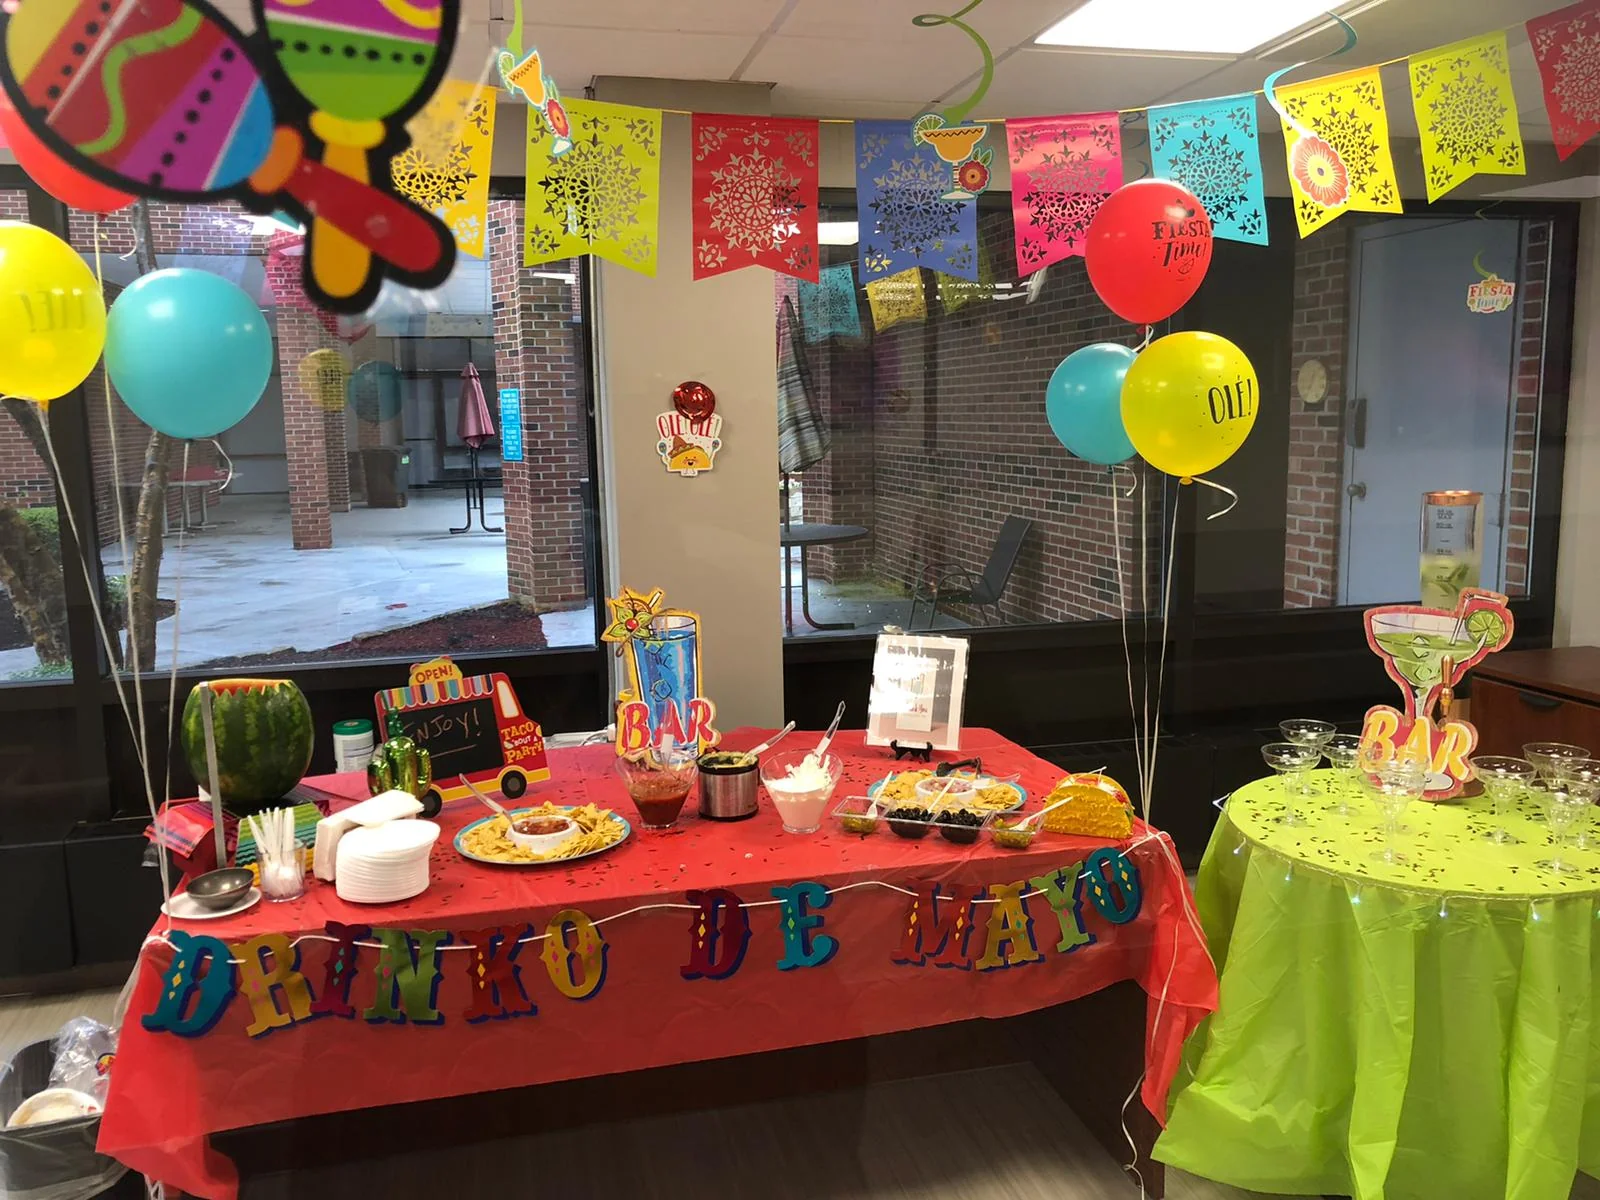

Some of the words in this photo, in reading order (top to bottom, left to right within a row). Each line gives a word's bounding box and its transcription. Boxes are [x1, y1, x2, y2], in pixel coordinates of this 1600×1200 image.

[1152, 220, 1210, 240] FIESTA
[1470, 284, 1512, 297] FIESTA
[416, 664, 453, 684] OPEN!
[501, 721, 534, 740] TACO
[621, 698, 717, 752] BAR
[505, 741, 543, 764] PARTY
[1360, 710, 1473, 781] BAR
[142, 909, 609, 1038] DRINKO
[679, 881, 840, 980] DE
[890, 847, 1143, 972] MAYO
